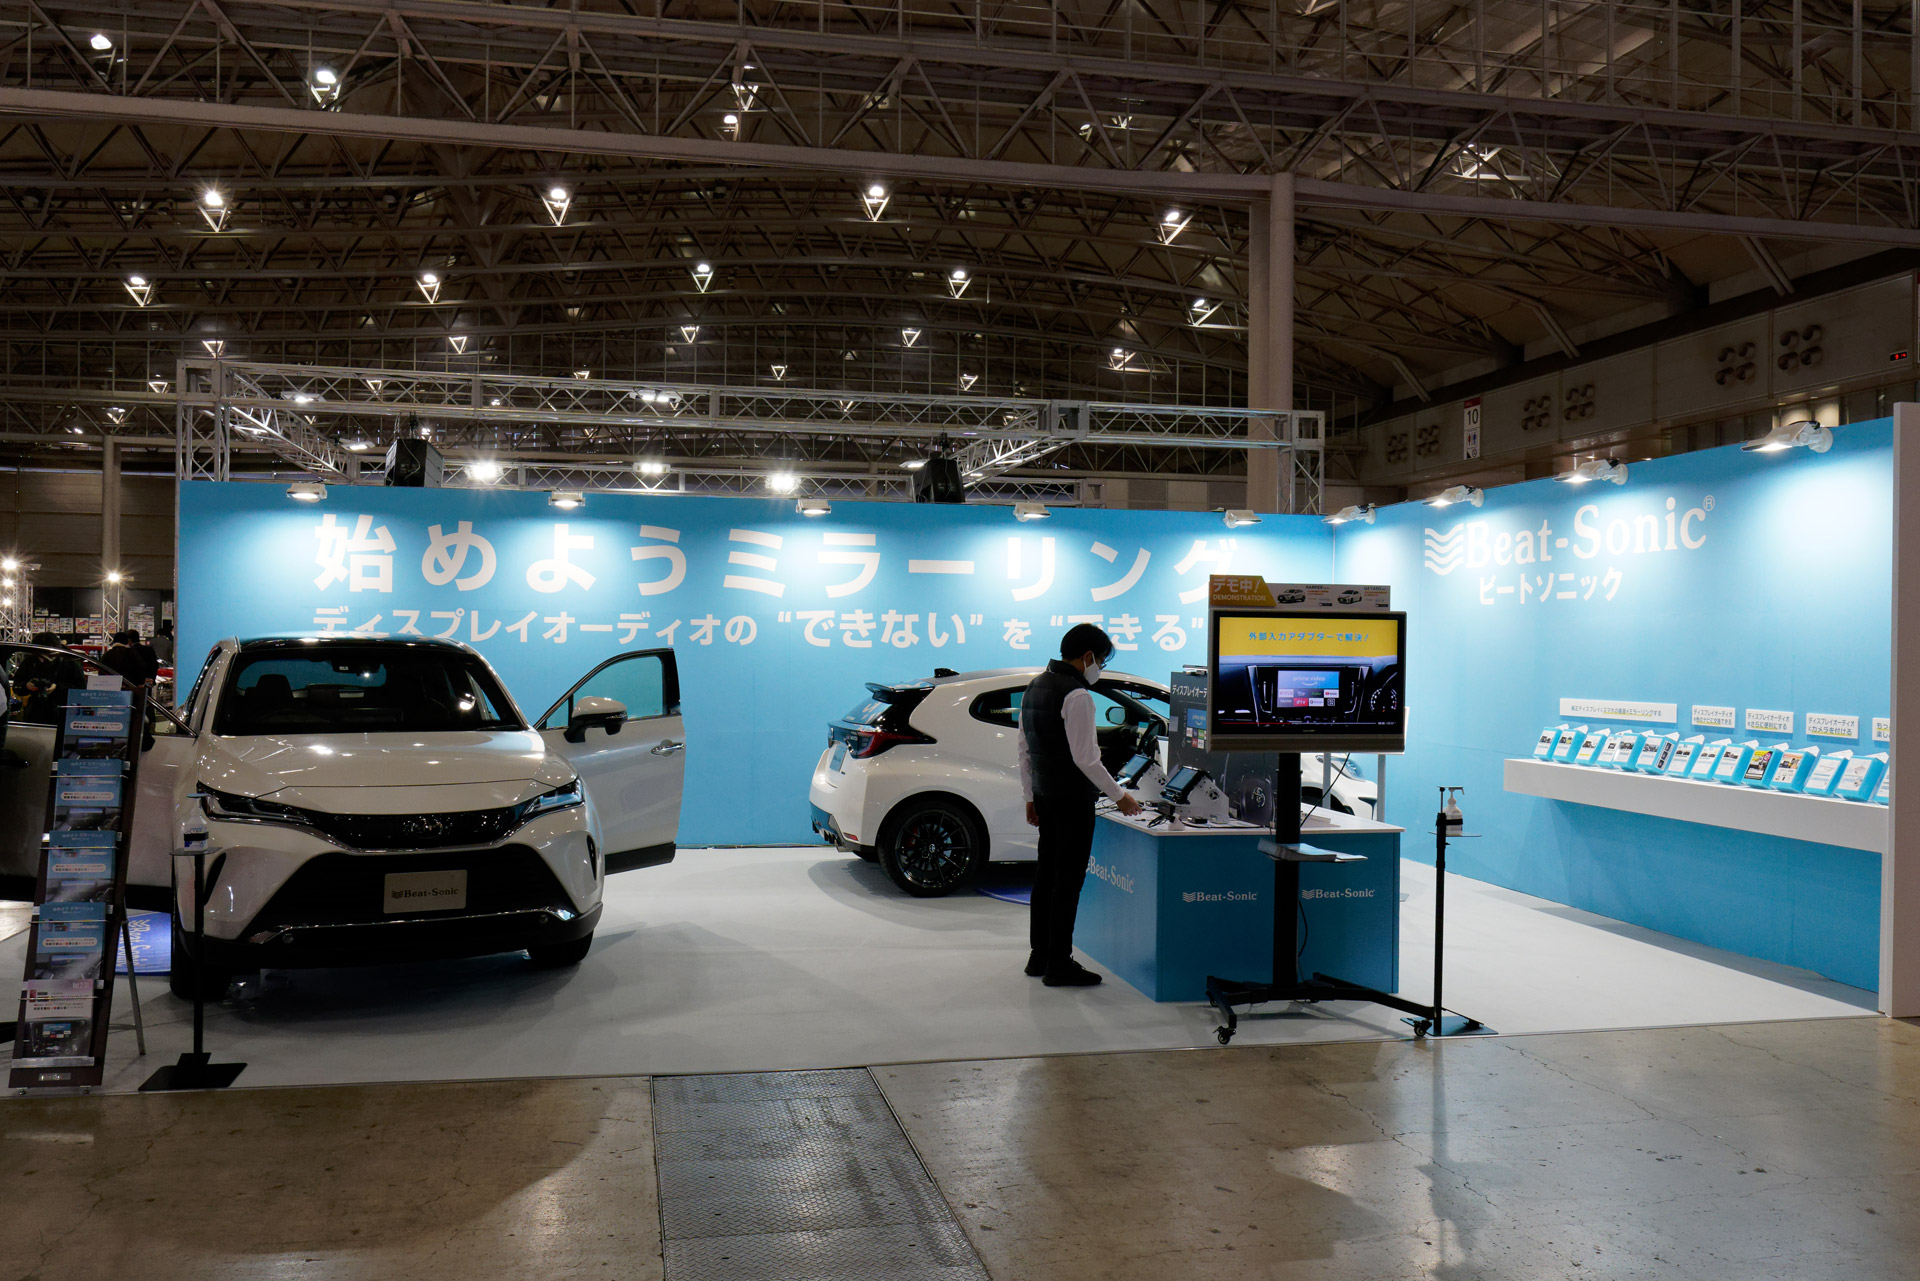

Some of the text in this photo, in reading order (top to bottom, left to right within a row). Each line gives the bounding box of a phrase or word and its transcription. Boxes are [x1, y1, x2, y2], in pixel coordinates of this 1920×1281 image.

[1467, 408, 1479, 425] 10
[313, 513, 1239, 606] 始めようミラーリング
[1479, 566, 1623, 605] ビートソニック
[1212, 594, 1266, 602] DEMONSTRATION
[1747, 712, 1790, 723] ディスプレイオーディオ
[1808, 716, 1855, 728] ディスプレイオーディオ
[404, 887, 460, 898] Beat-Sonic
